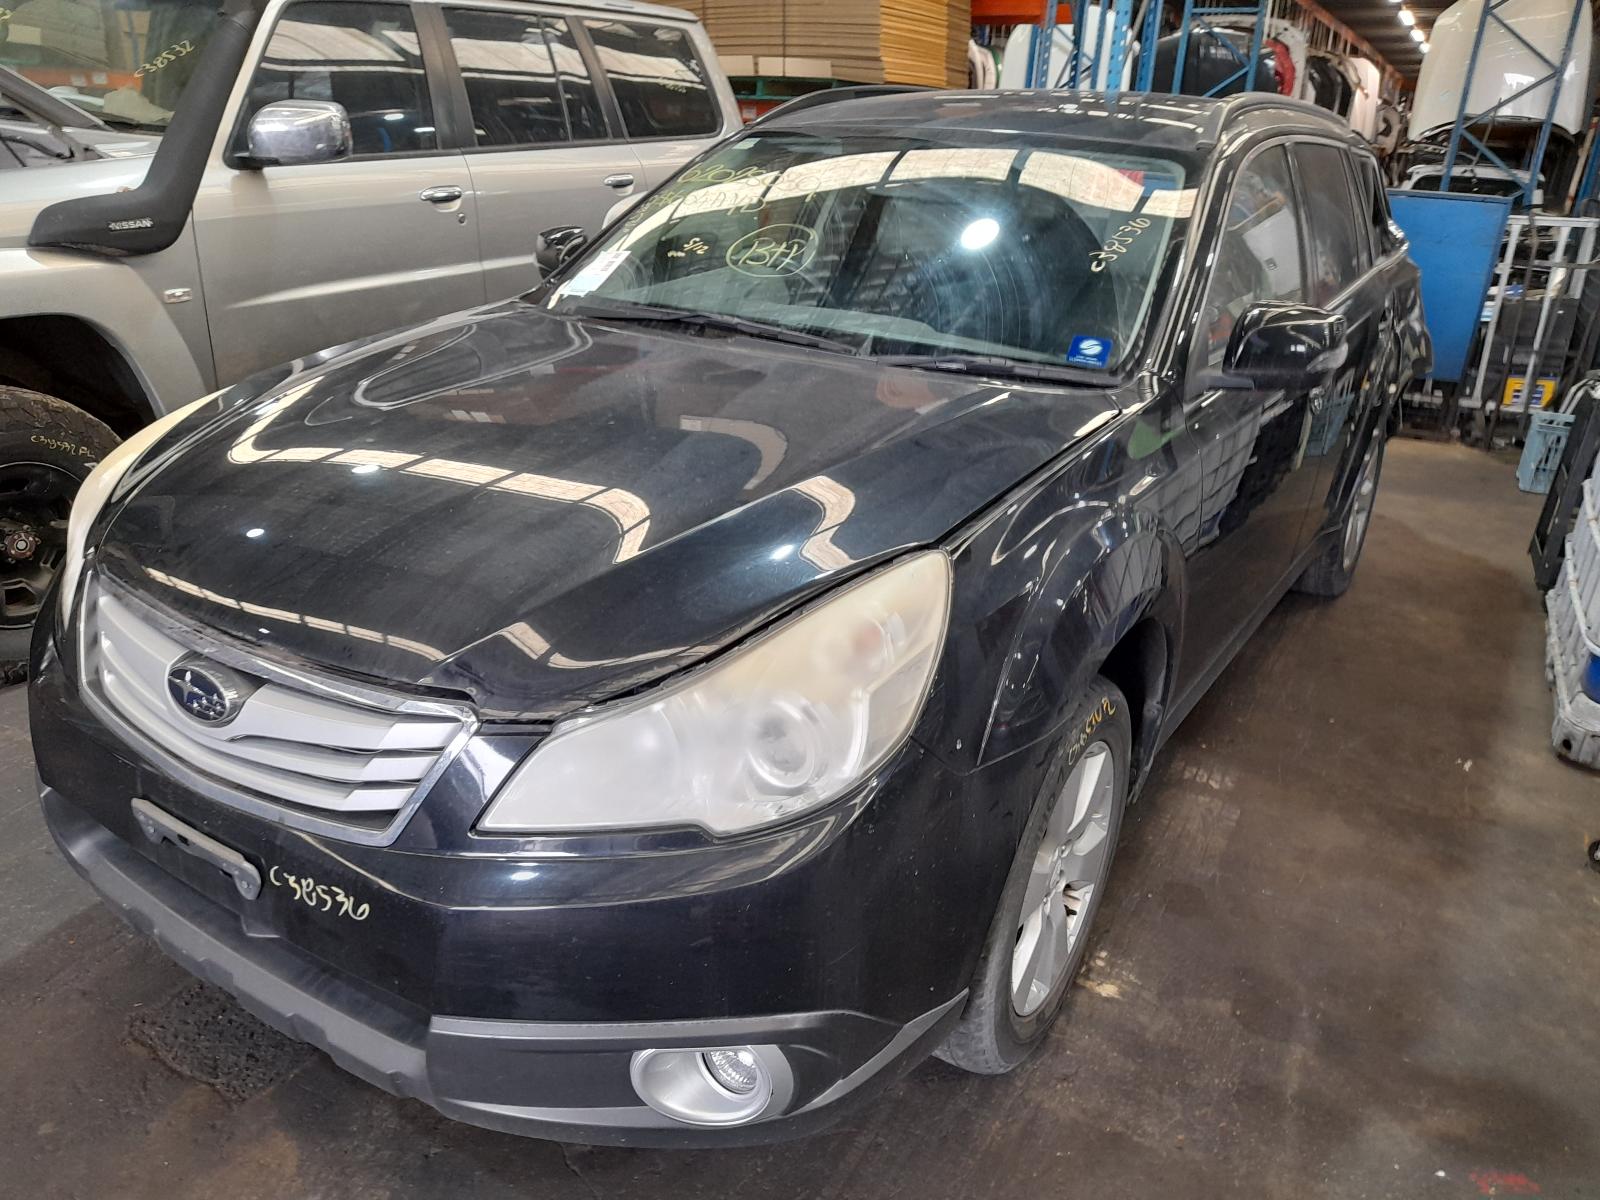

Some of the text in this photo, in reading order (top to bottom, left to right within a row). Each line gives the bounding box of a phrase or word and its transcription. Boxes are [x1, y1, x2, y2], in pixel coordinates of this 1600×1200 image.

[108, 218, 154, 231] NISSAN
[1088, 217, 1151, 273] C38536
[269, 865, 371, 921] C38536
